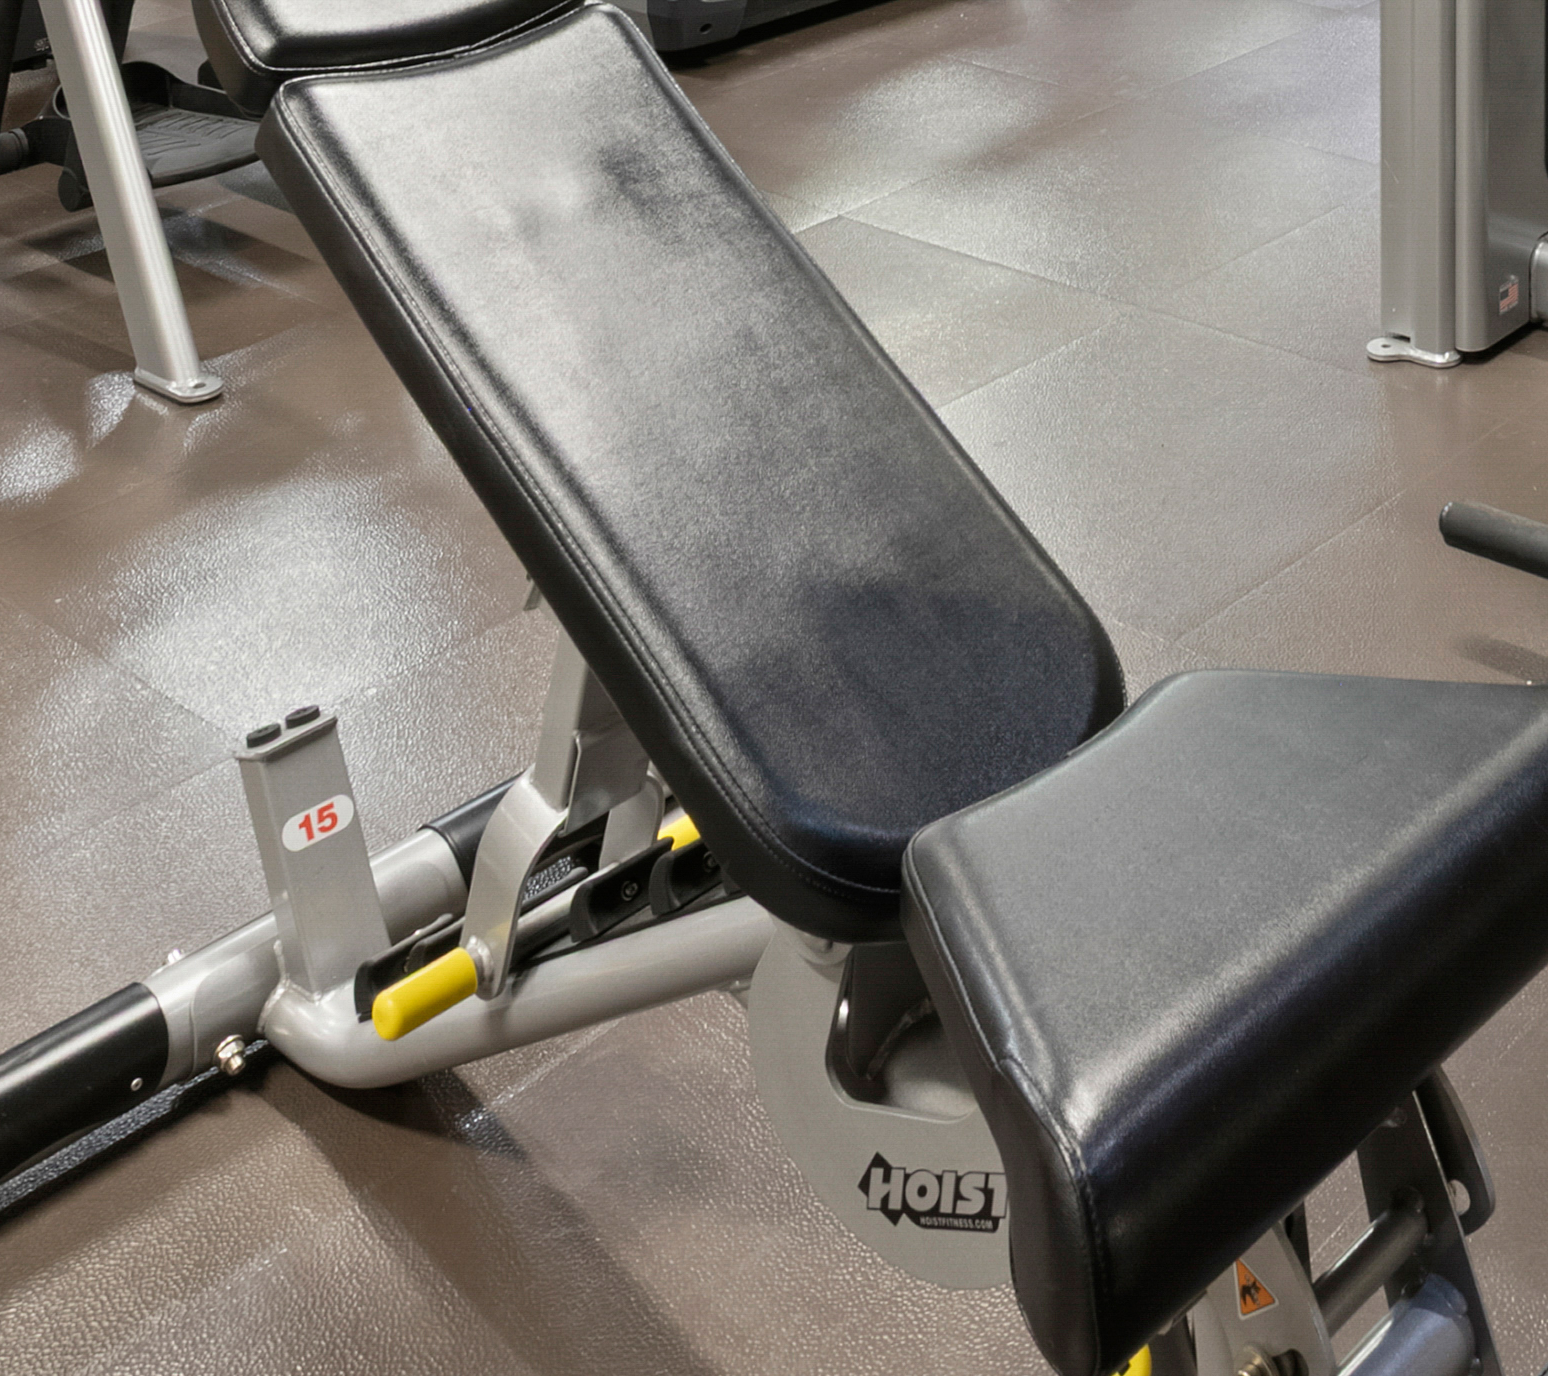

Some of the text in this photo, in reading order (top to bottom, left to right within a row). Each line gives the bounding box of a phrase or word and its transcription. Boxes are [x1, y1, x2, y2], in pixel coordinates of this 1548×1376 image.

[298, 801, 338, 842] 15
[867, 1167, 1007, 1218] HOIST
[919, 1216, 993, 1229] HOISTFITNESS.COM
